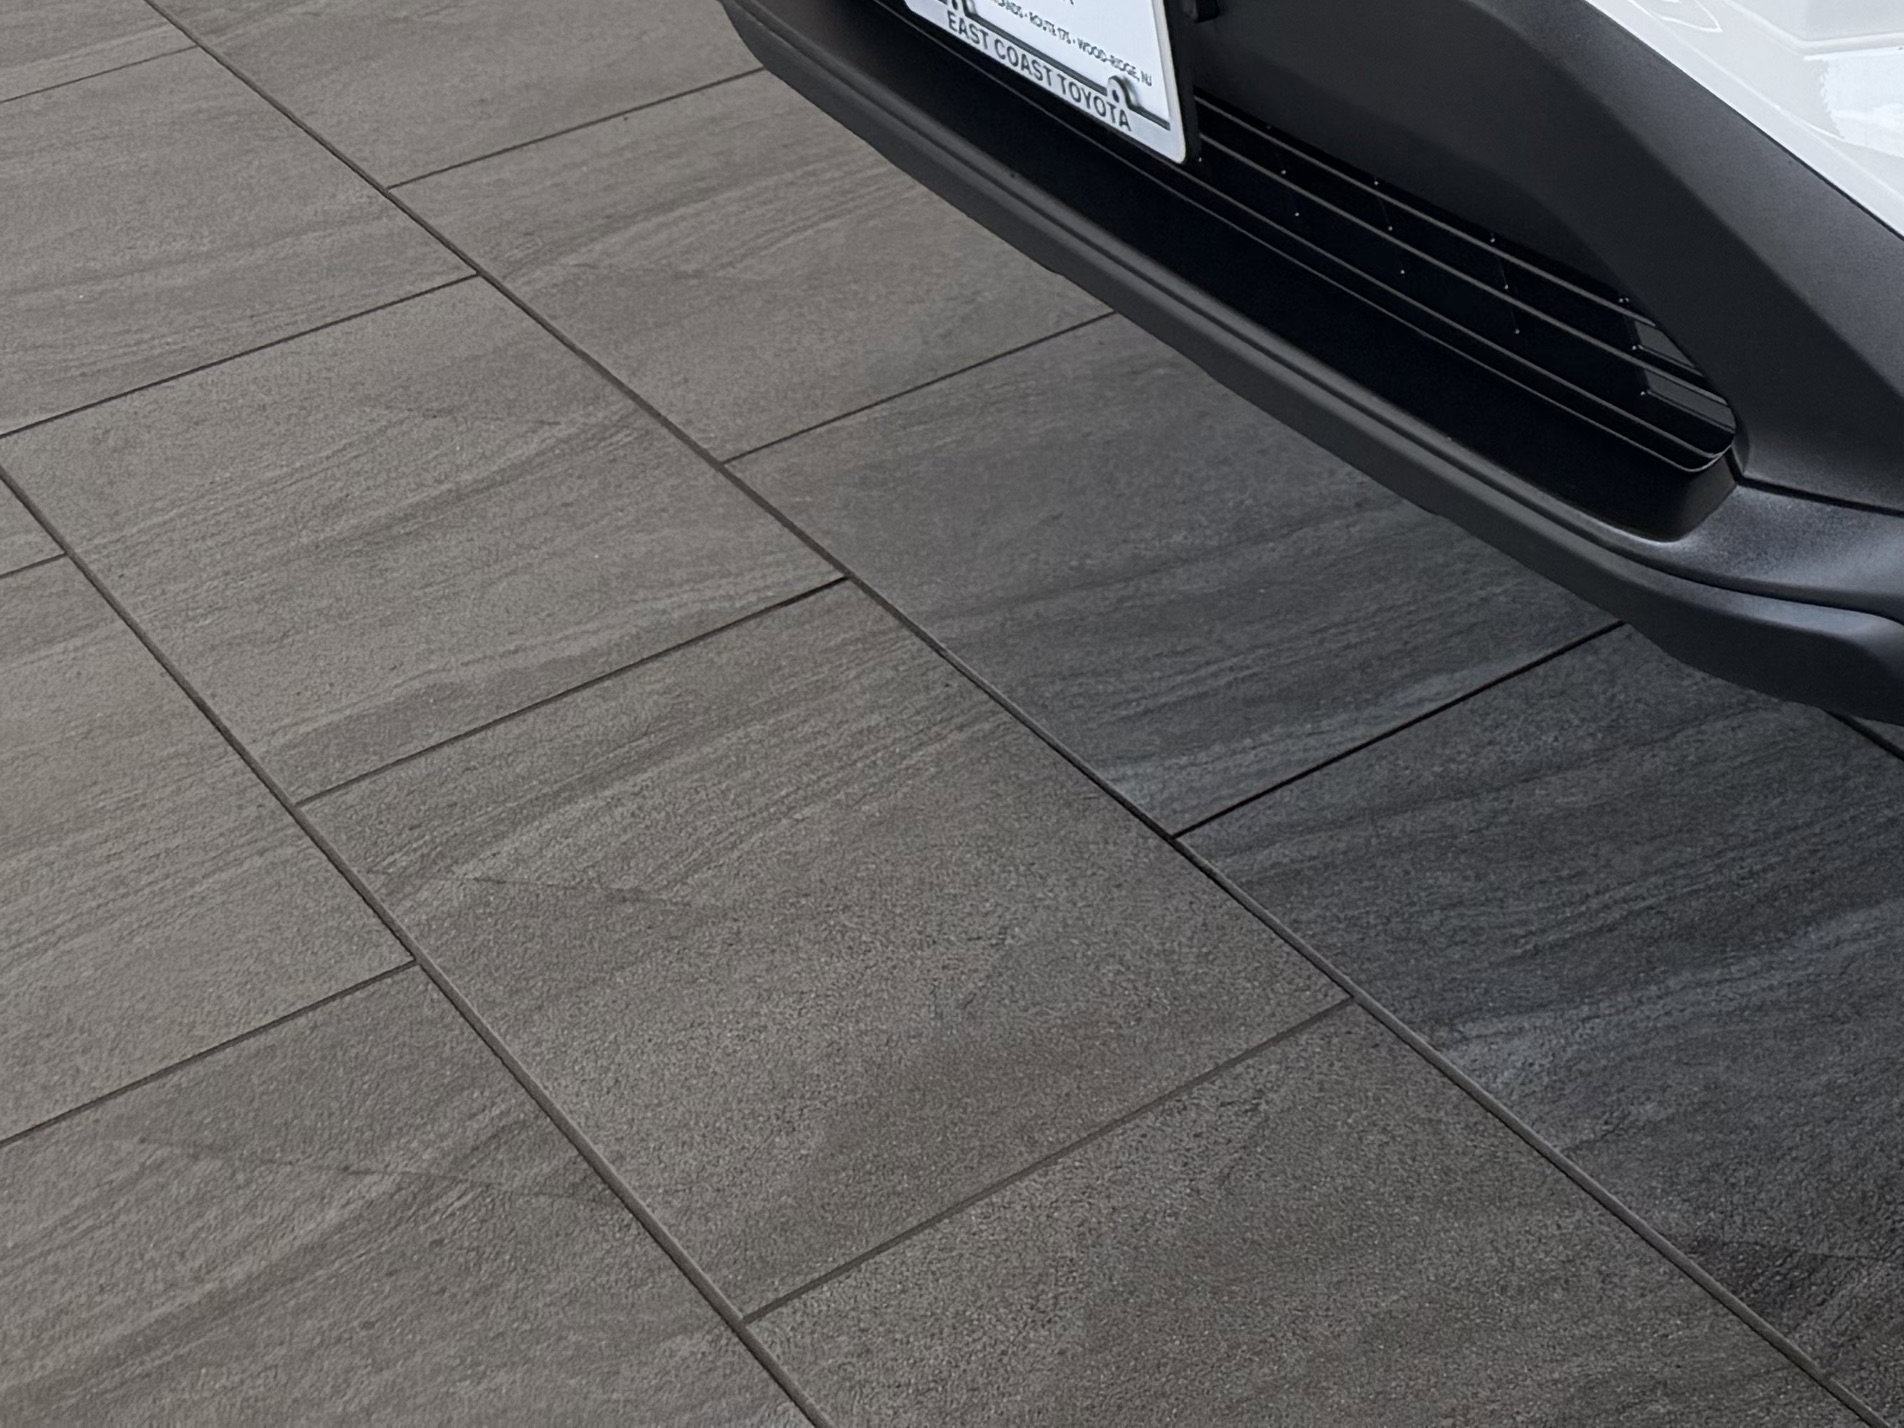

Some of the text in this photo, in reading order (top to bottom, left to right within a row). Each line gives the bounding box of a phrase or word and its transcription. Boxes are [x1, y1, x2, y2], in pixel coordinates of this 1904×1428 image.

[947, 9, 1132, 132] EAST COAST TOYOTA
